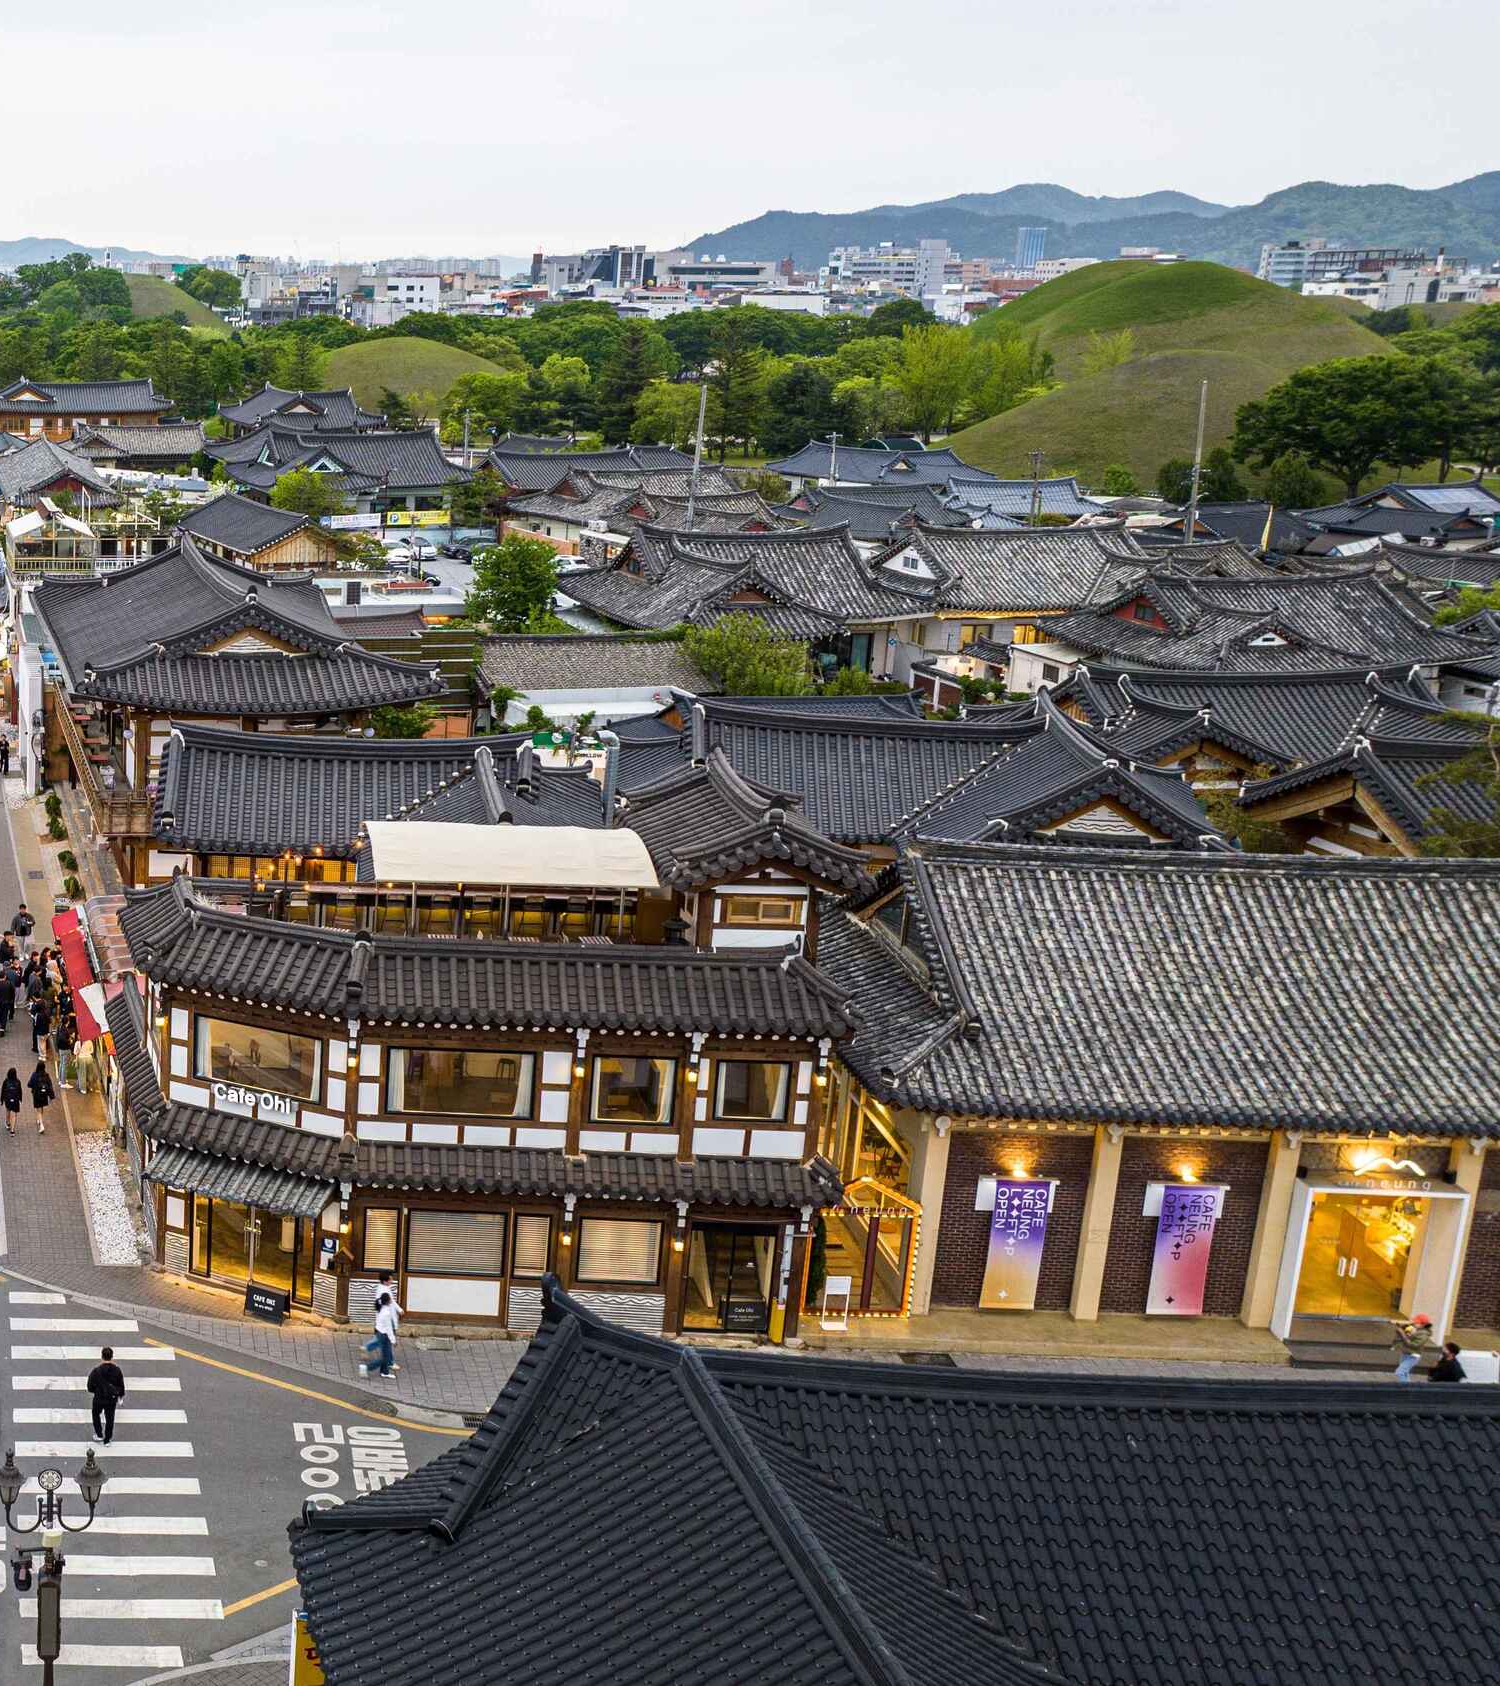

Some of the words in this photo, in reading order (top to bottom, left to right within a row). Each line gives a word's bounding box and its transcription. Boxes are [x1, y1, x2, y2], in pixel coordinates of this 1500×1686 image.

[214, 1083, 256, 1106] Cafe
[260, 1092, 291, 1115] Ohi
[1366, 1178, 1431, 1191] neung
[994, 1187, 1010, 1228] OPEN
[1018, 1189, 1034, 1240] NEUNG
[1032, 1188, 1048, 1228] CAFE
[1161, 1193, 1176, 1233] OPEN
[1184, 1194, 1202, 1244] NEUNG
[1199, 1194, 1216, 1233] CAFE
